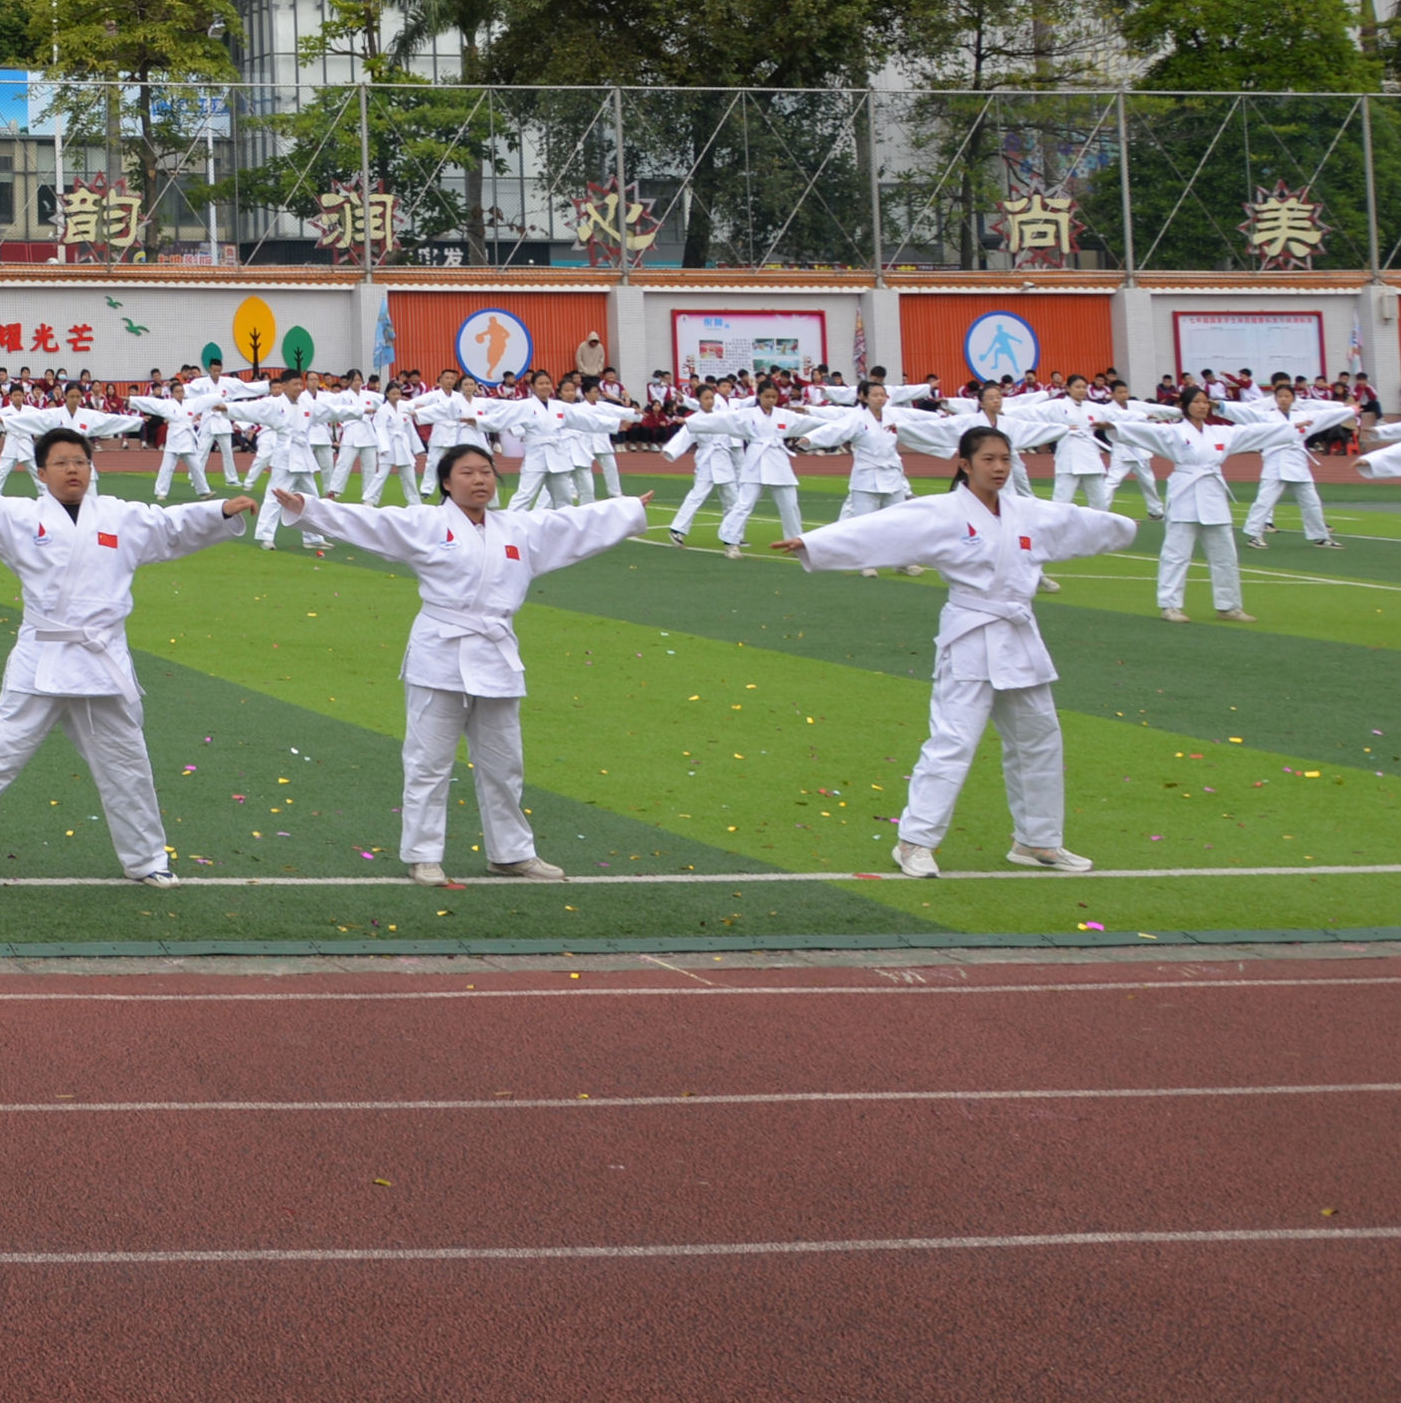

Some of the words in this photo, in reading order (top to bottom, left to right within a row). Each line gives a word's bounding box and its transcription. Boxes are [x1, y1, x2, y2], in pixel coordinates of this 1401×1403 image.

[62, 188, 141, 247] 韵
[319, 191, 394, 252] 润
[577, 192, 657, 251] 心
[1252, 197, 1322, 258] 美
